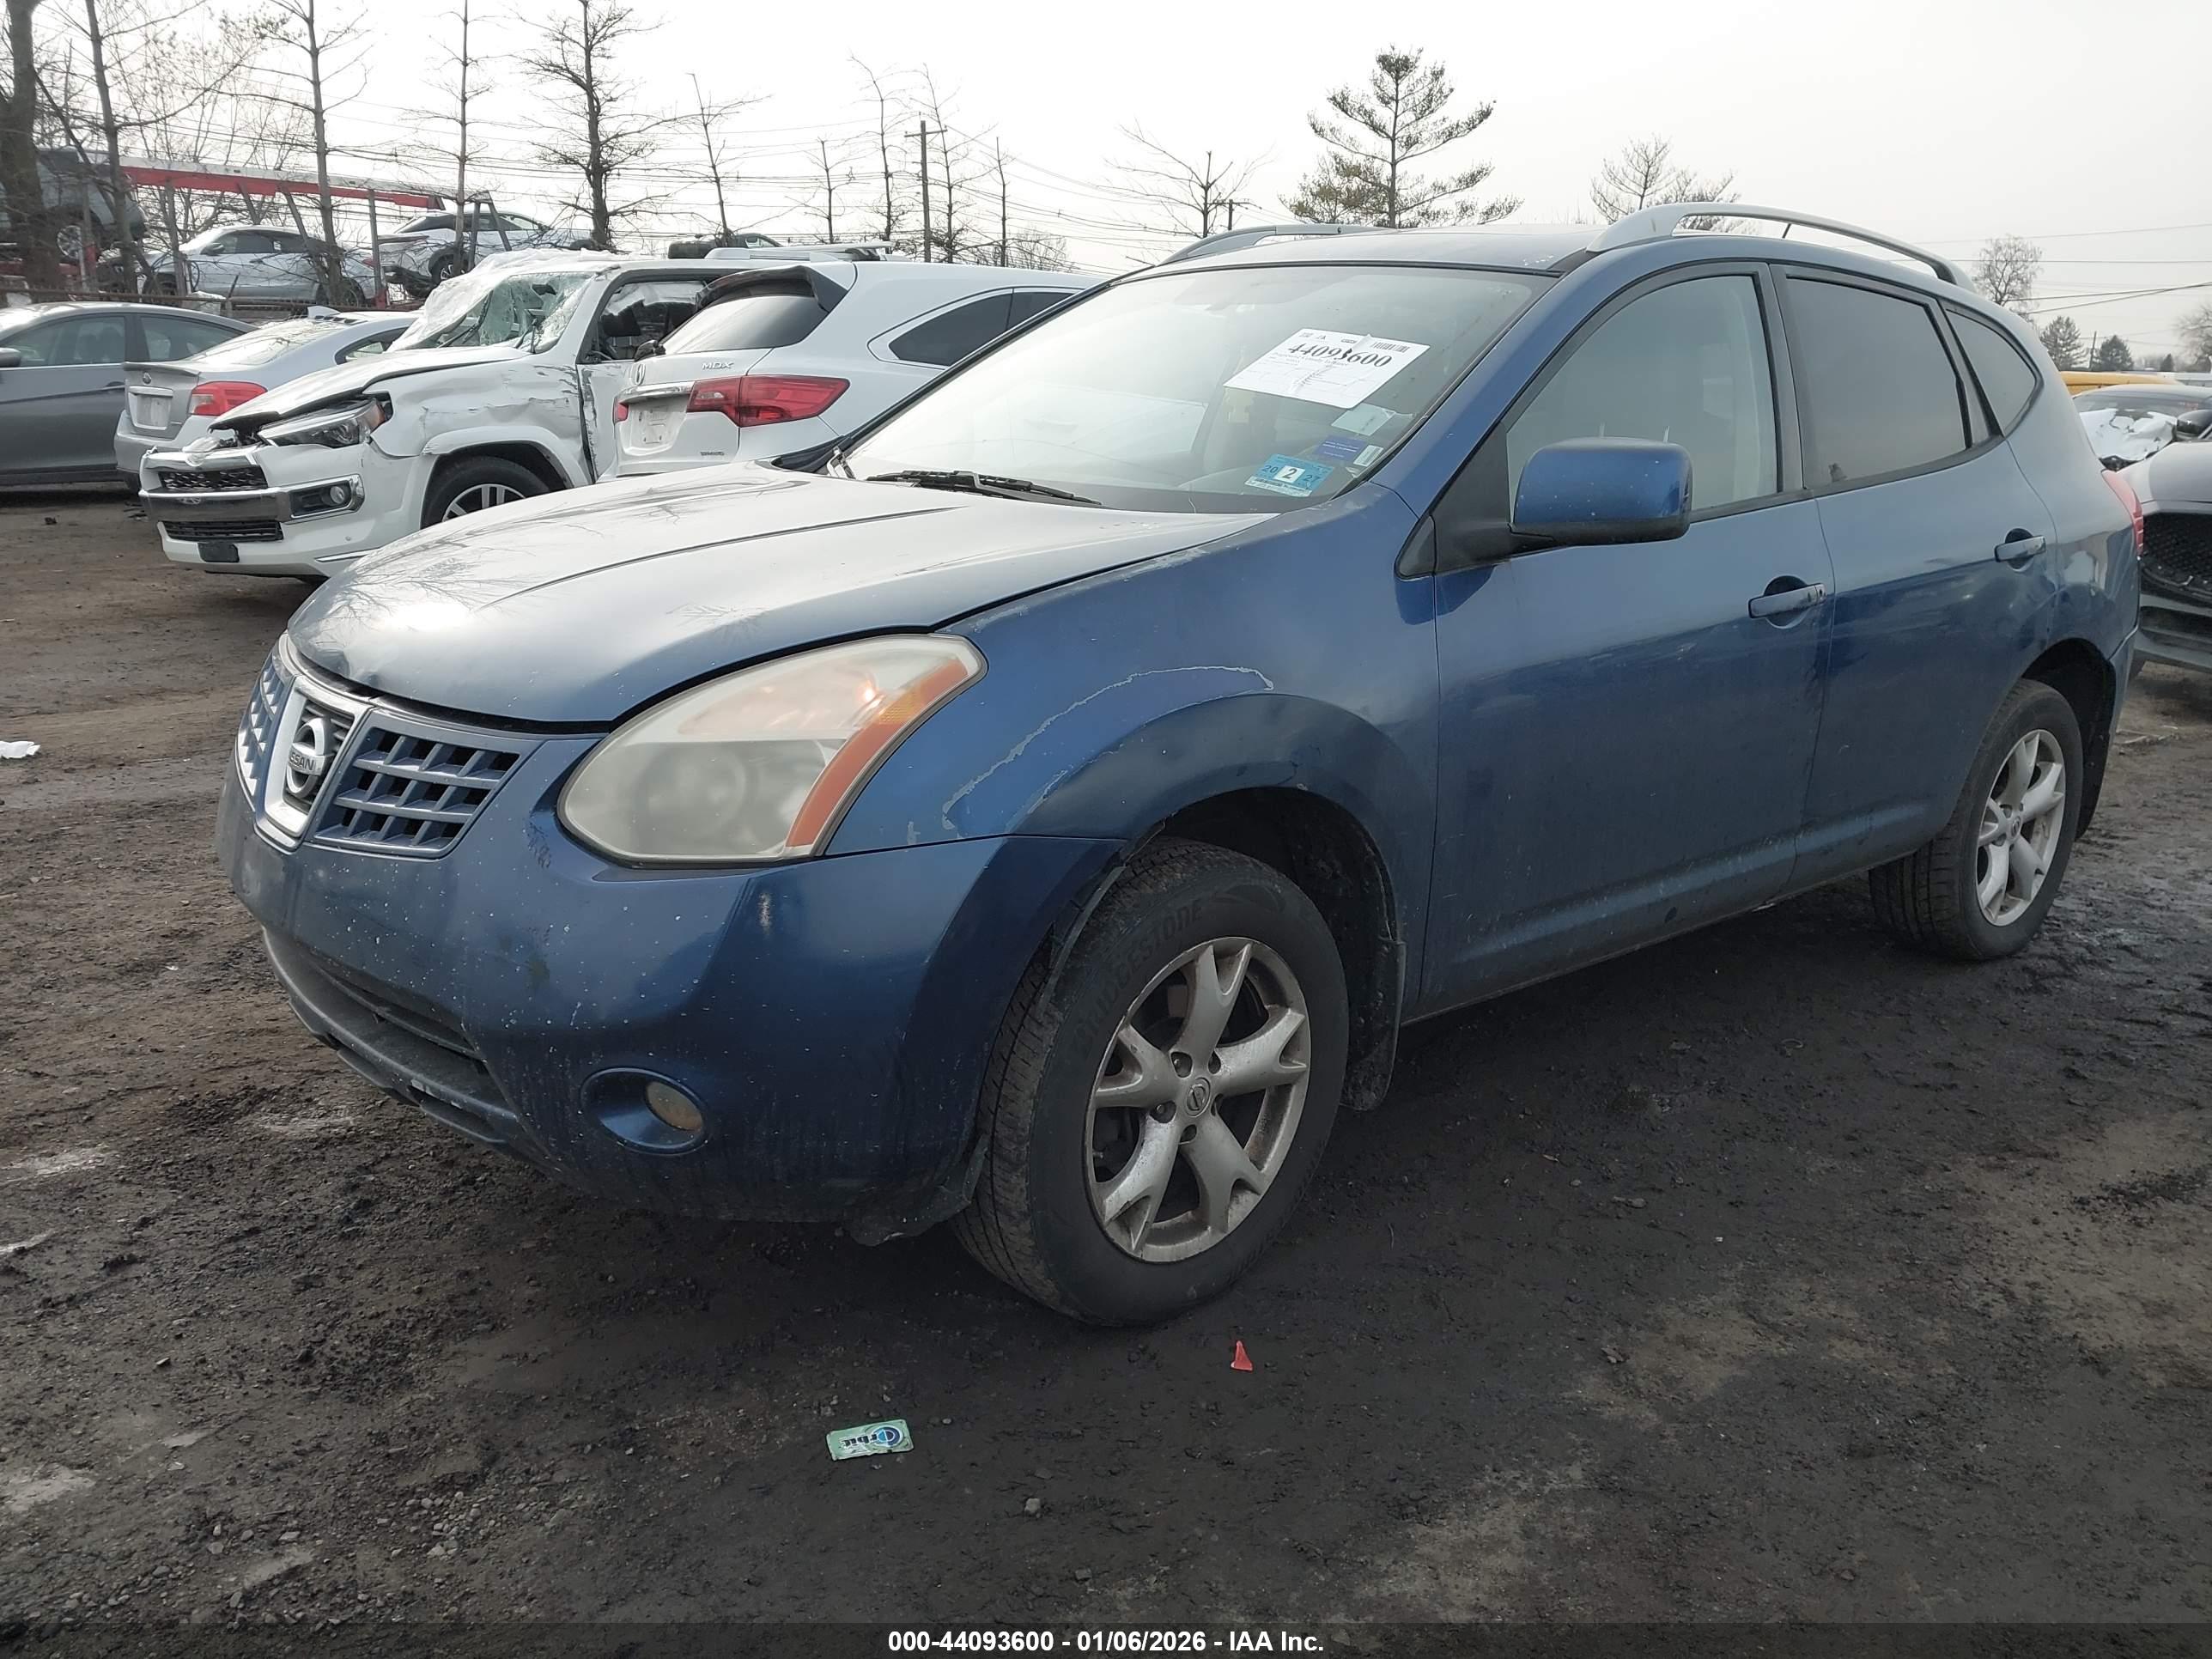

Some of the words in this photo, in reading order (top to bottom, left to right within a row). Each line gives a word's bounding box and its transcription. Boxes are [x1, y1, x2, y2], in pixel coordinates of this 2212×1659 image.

[702, 362, 734, 370] MDX
[1262, 465, 1279, 474] 20
[1282, 468, 1297, 479] 2
[289, 751, 314, 770] SSAN
